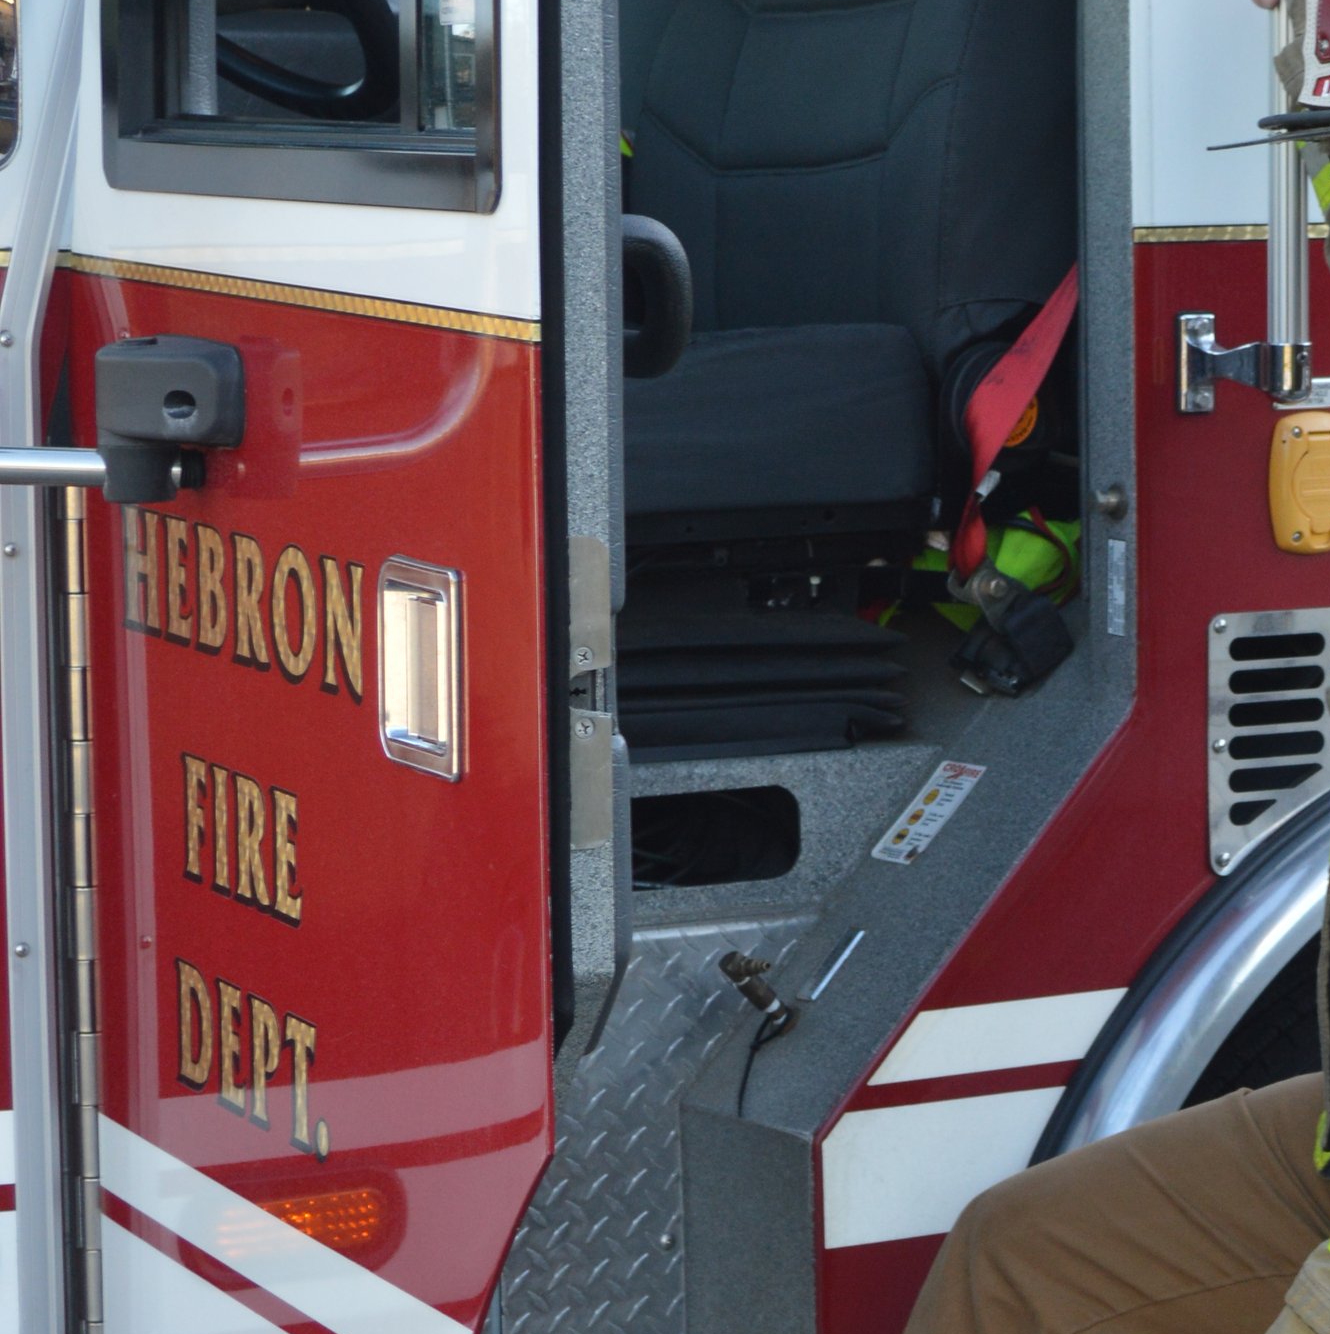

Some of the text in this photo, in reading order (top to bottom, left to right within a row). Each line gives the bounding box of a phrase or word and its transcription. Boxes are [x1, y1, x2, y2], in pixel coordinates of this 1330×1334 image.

[122, 503, 366, 704] HEBRON
[180, 750, 305, 928] FIRE
[175, 957, 332, 1164] DEPT.
